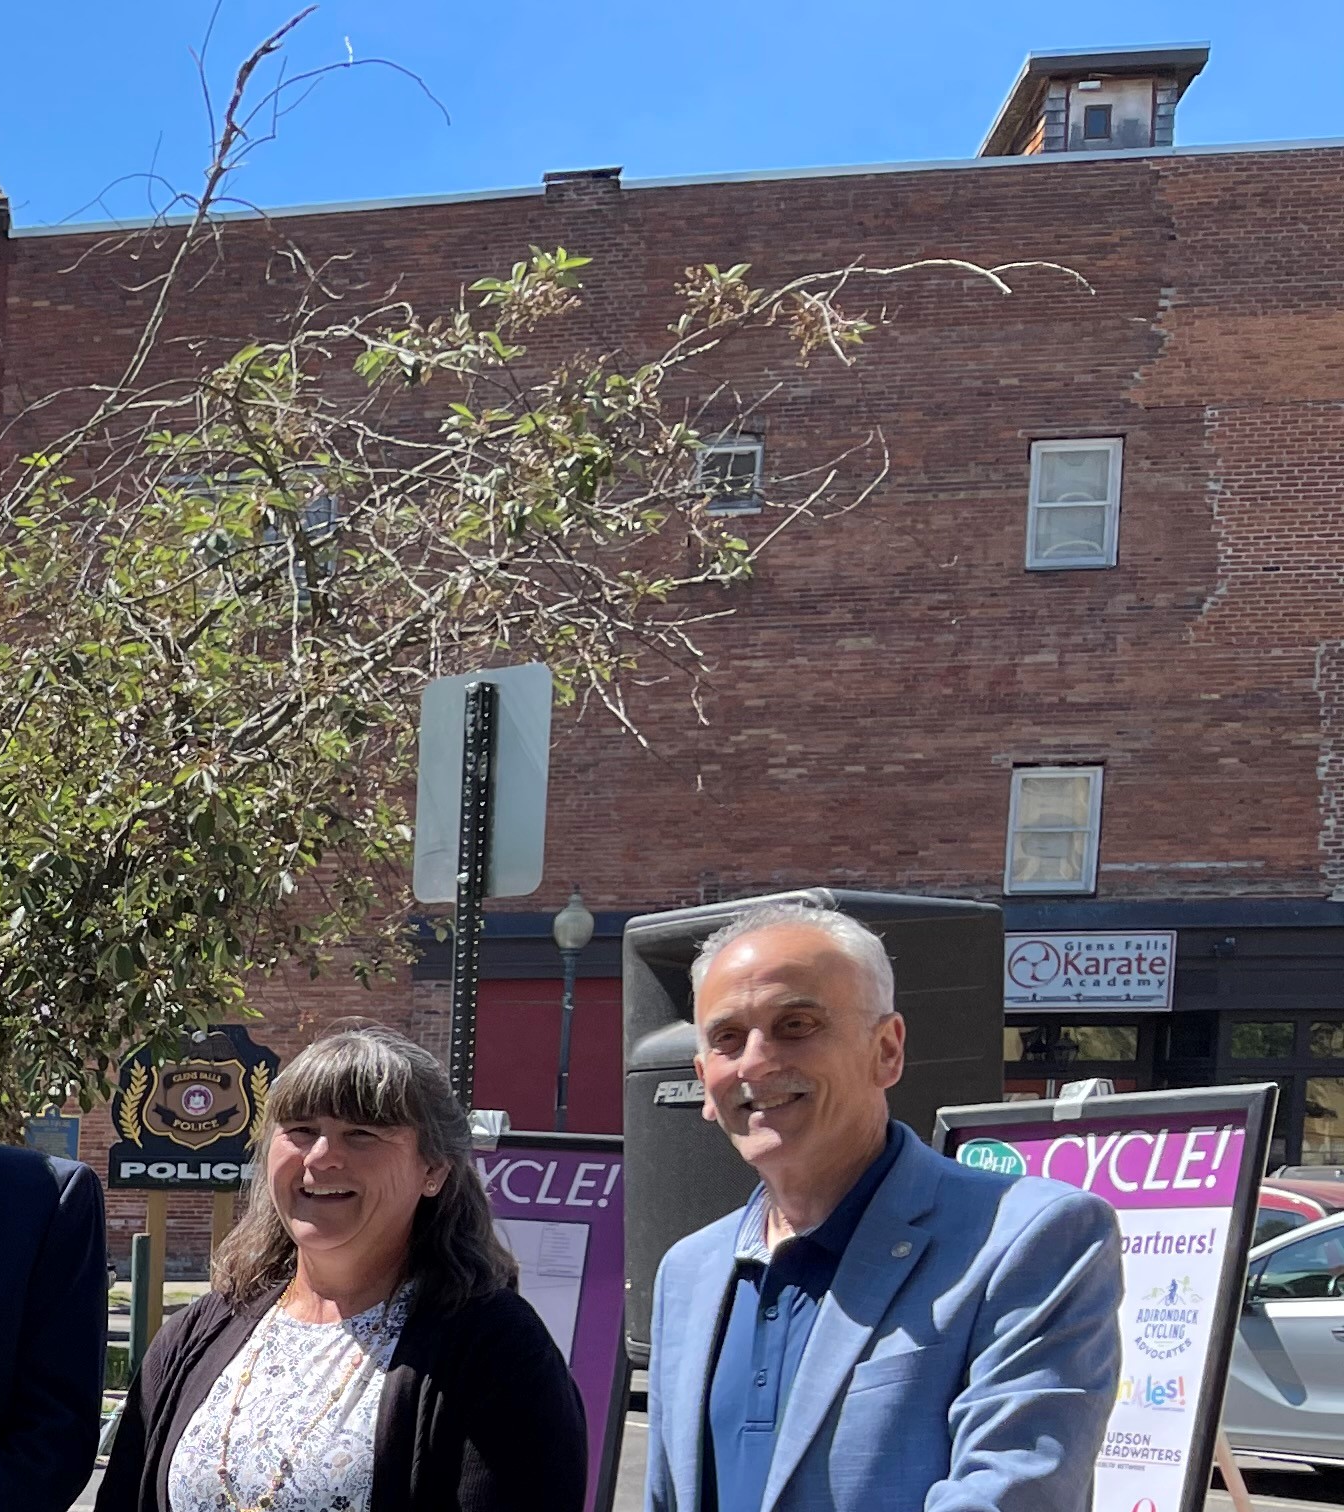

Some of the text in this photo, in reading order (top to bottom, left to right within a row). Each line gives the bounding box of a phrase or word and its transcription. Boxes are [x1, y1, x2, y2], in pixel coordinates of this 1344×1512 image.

[1064, 940, 1169, 952] Glens Falls
[1063, 952, 1167, 976] Karate
[1062, 976, 1166, 988] Academy
[172, 1071, 222, 1083] GLENS FALLS
[172, 1118, 220, 1132] POLICE
[1040, 1125, 1233, 1193] CYCLE!
[476, 1156, 622, 1209] YCLE!
[1135, 1308, 1201, 1325] ADIRONDACK
[1144, 1323, 1186, 1339] CYCLING
[1133, 1335, 1193, 1360] ADVOCATES
[1106, 1431, 1152, 1446] UDSON
[1100, 1444, 1182, 1462] EADWATERS
